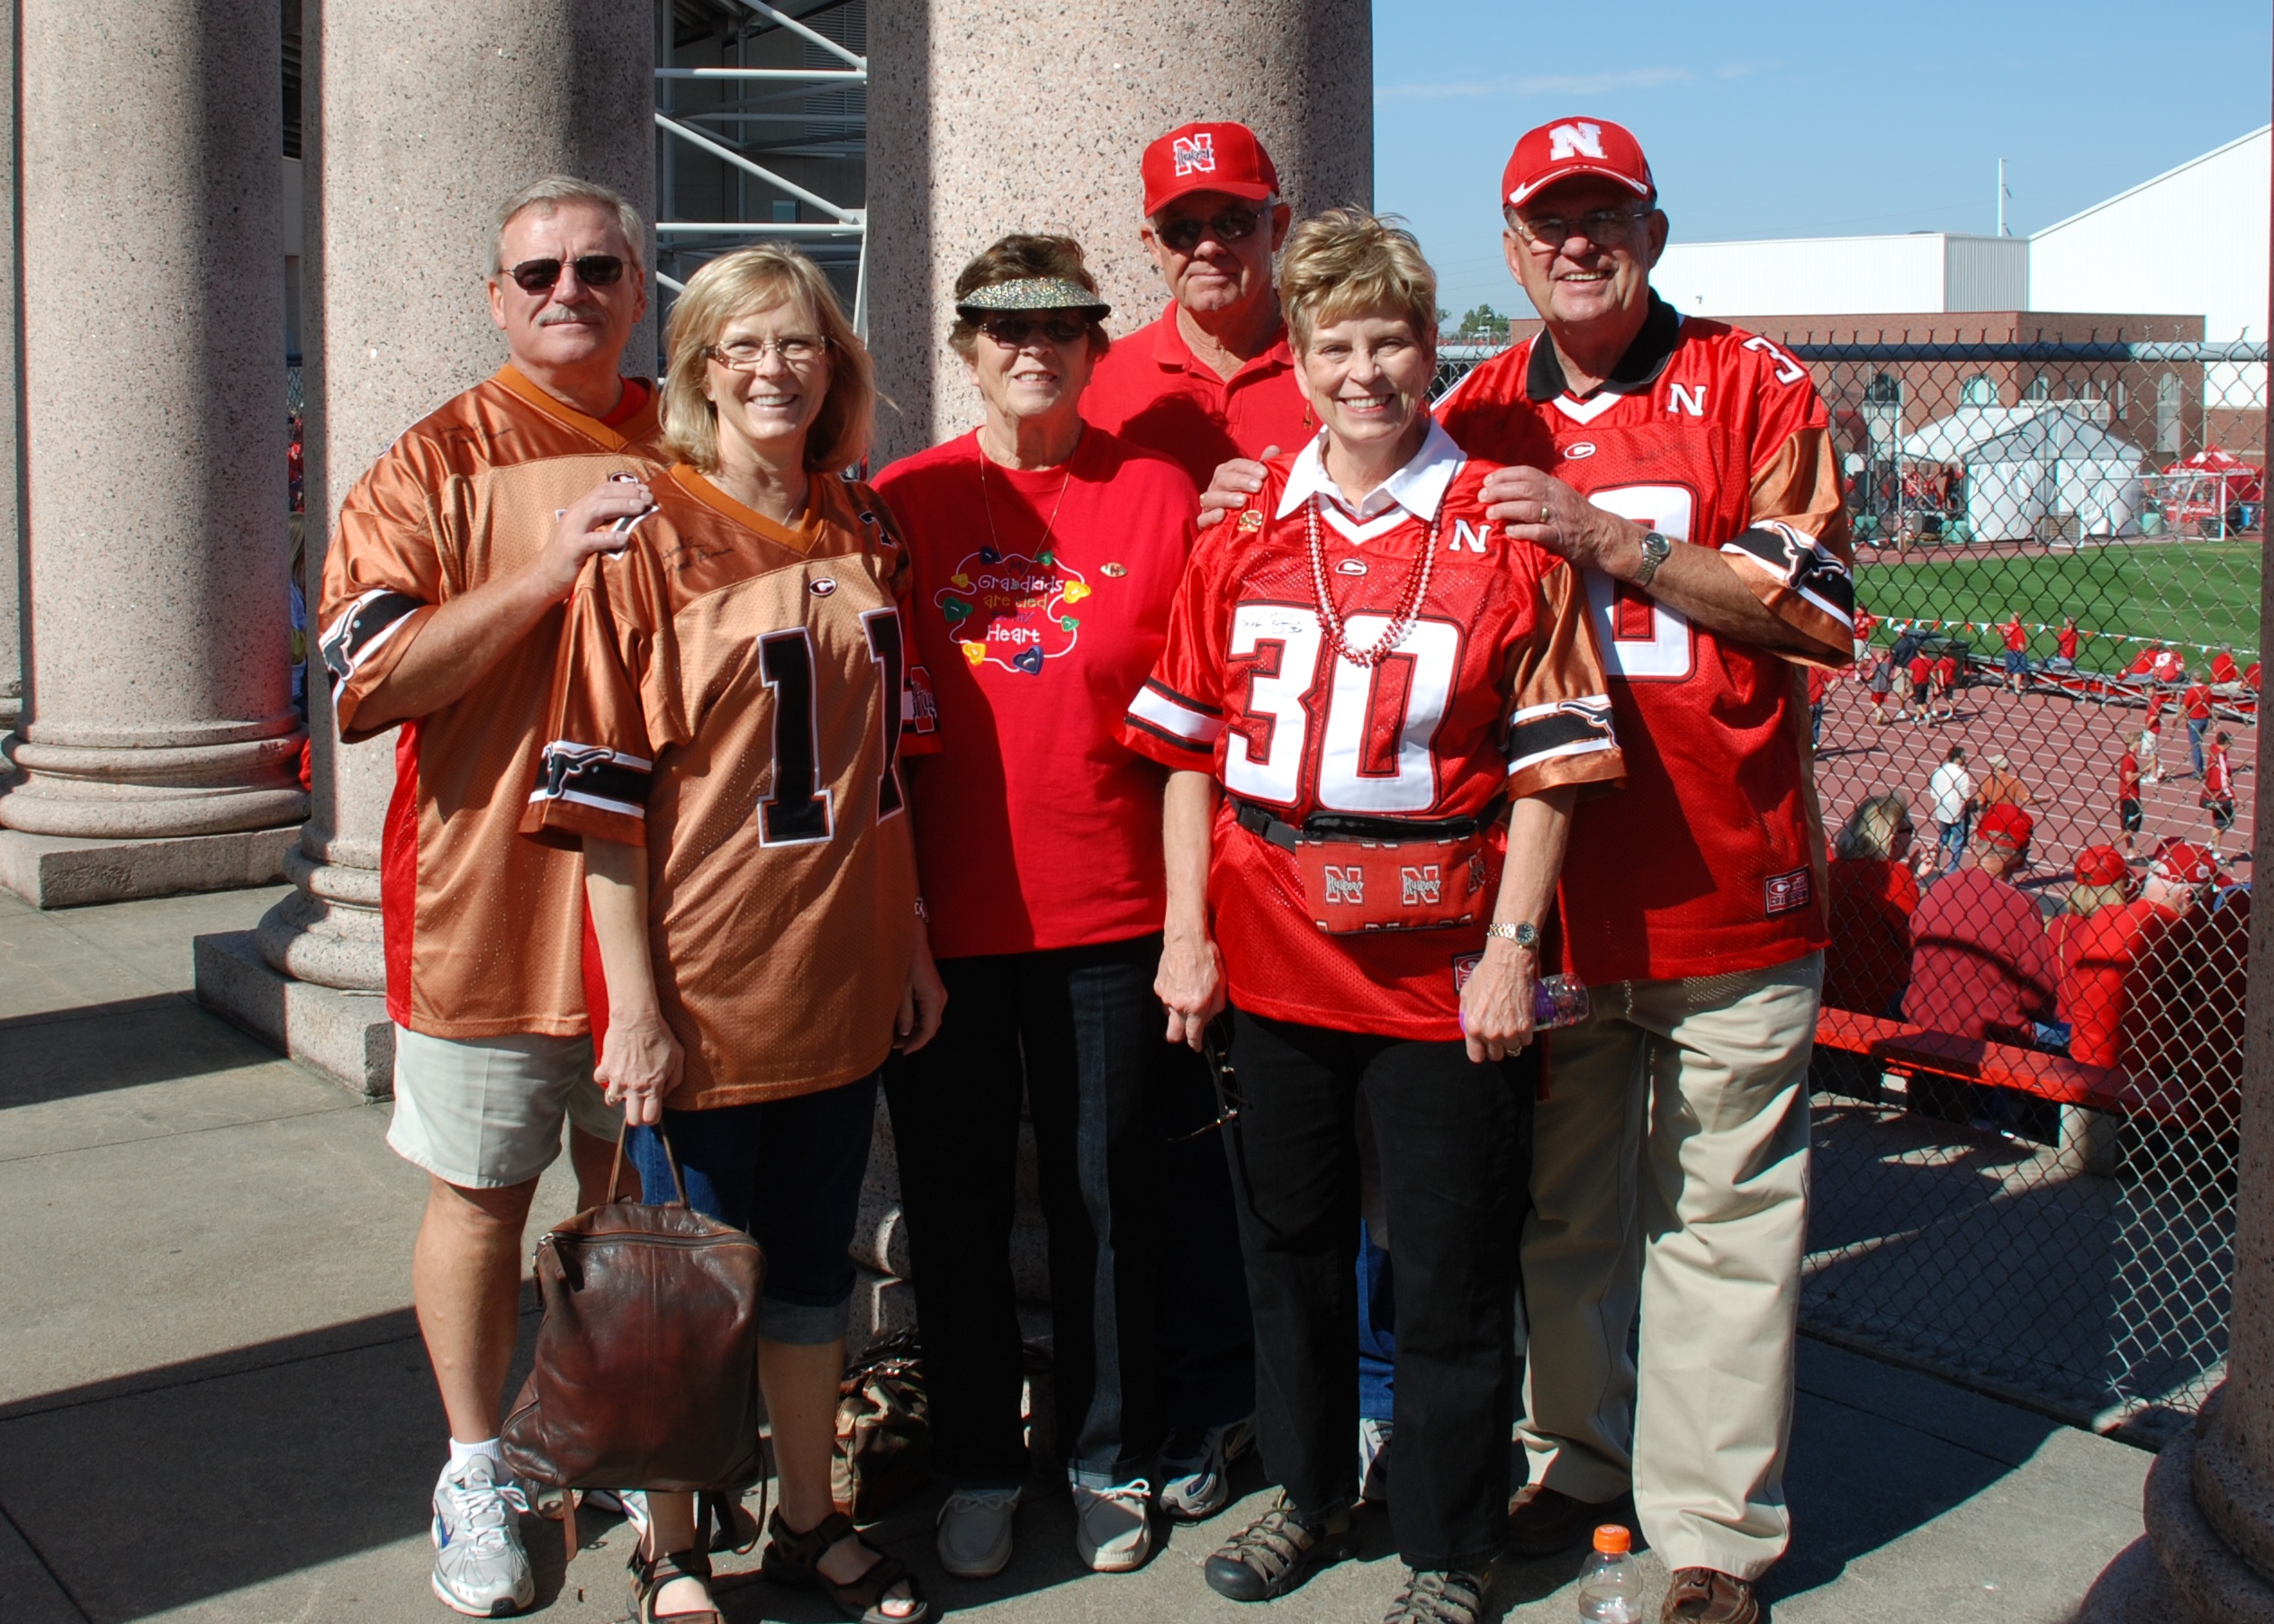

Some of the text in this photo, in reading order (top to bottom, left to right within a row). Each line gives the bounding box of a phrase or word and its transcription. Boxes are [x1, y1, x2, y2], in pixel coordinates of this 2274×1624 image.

[1173, 132, 1215, 177] N
[1549, 122, 1603, 161] N
[1667, 383, 1706, 416] N
[1449, 519, 1491, 553] N
[984, 593, 1047, 610] are tied
[987, 625, 1040, 644] Heart
[1223, 602, 1462, 812] 30
[1323, 864, 1365, 905] N
[1402, 864, 1440, 906] N
